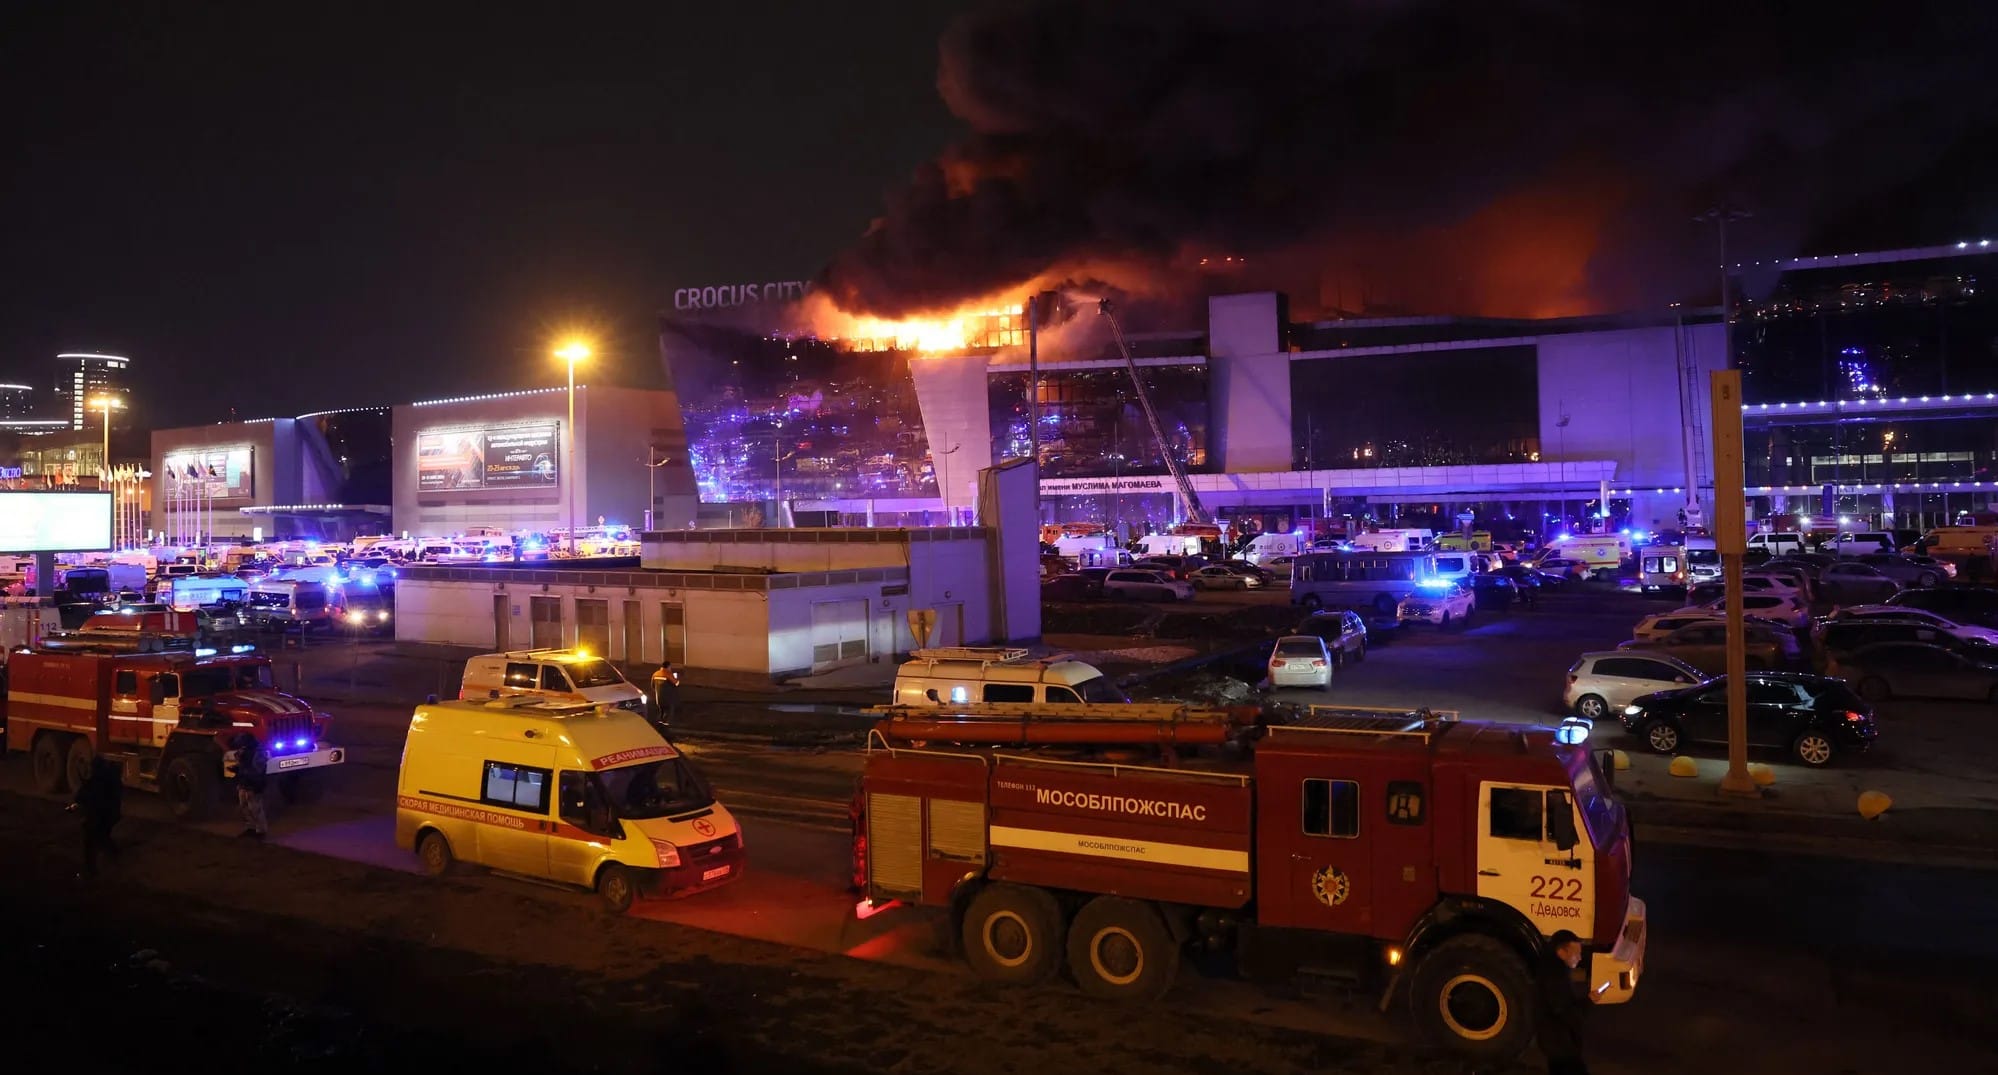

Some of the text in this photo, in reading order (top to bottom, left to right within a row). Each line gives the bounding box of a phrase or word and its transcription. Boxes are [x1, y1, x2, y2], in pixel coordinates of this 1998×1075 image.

[674, 280, 813, 310] CROCUS CITY
[1072, 482, 1110, 490] МУСЛИМА
[1111, 480, 1162, 489] МАГОМАЕВА
[40, 622, 56, 631] 112
[600, 747, 669, 766] РЕАНИМАЦИЯ
[400, 797, 525, 829] СКОРАЯ МЕДИЦИНСКАЯ ПОМОЩЬ
[1036, 788, 1207, 822] МОСОБЛПОЖСПАС
[1078, 840, 1146, 854] МОСОБЛПОЖСПАС
[1530, 875, 1583, 902] 222
[1530, 901, 1581, 918] г.Дедовск
